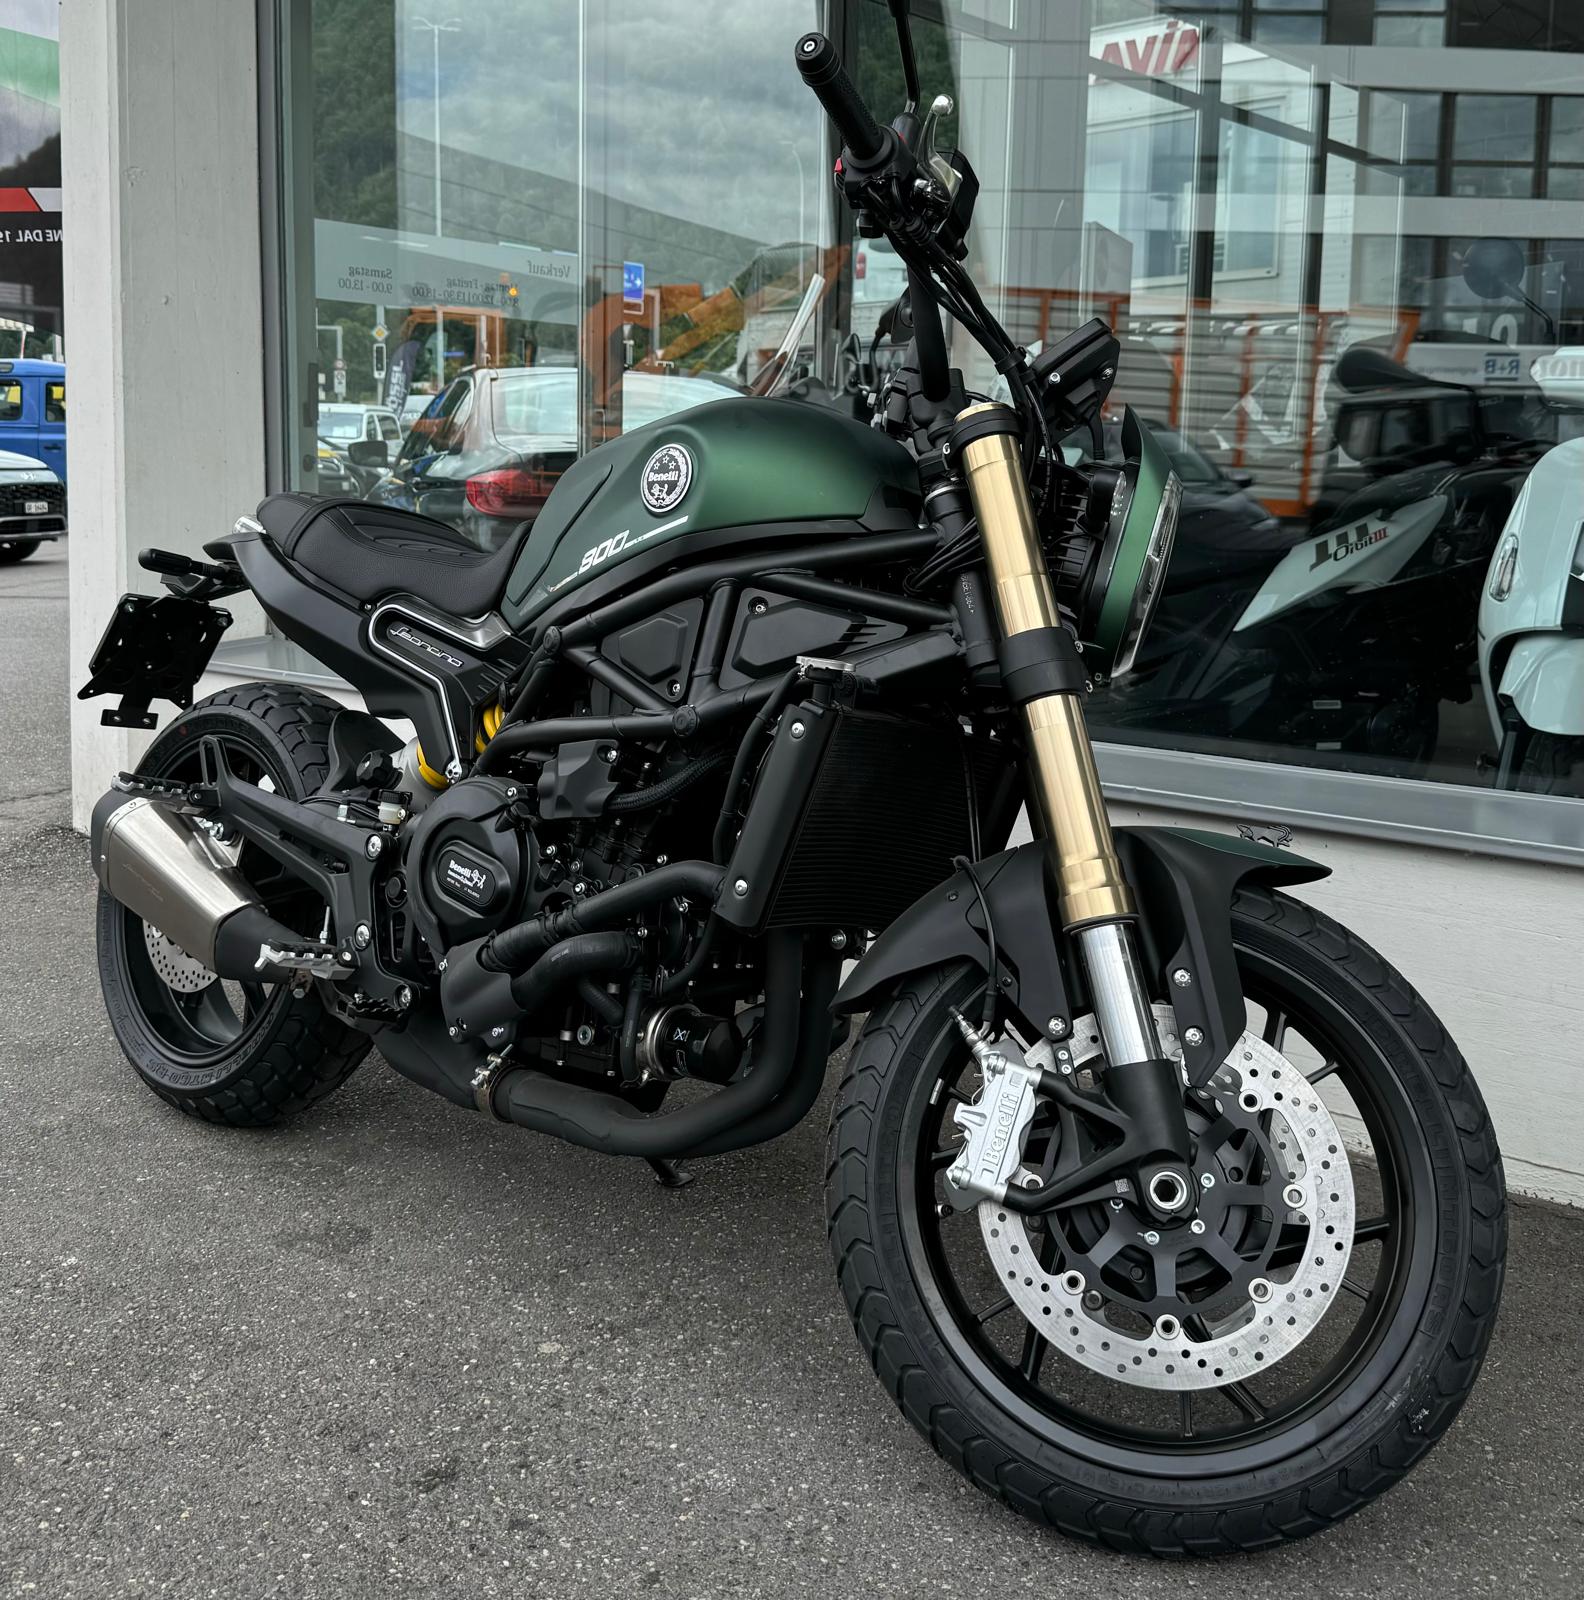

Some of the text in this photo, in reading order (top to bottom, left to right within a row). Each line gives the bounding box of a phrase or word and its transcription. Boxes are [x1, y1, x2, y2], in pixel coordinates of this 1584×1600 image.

[648, 470, 679, 482] Benelli
[579, 529, 630, 574] 800
[981, 1091, 1020, 1166] Benelli
